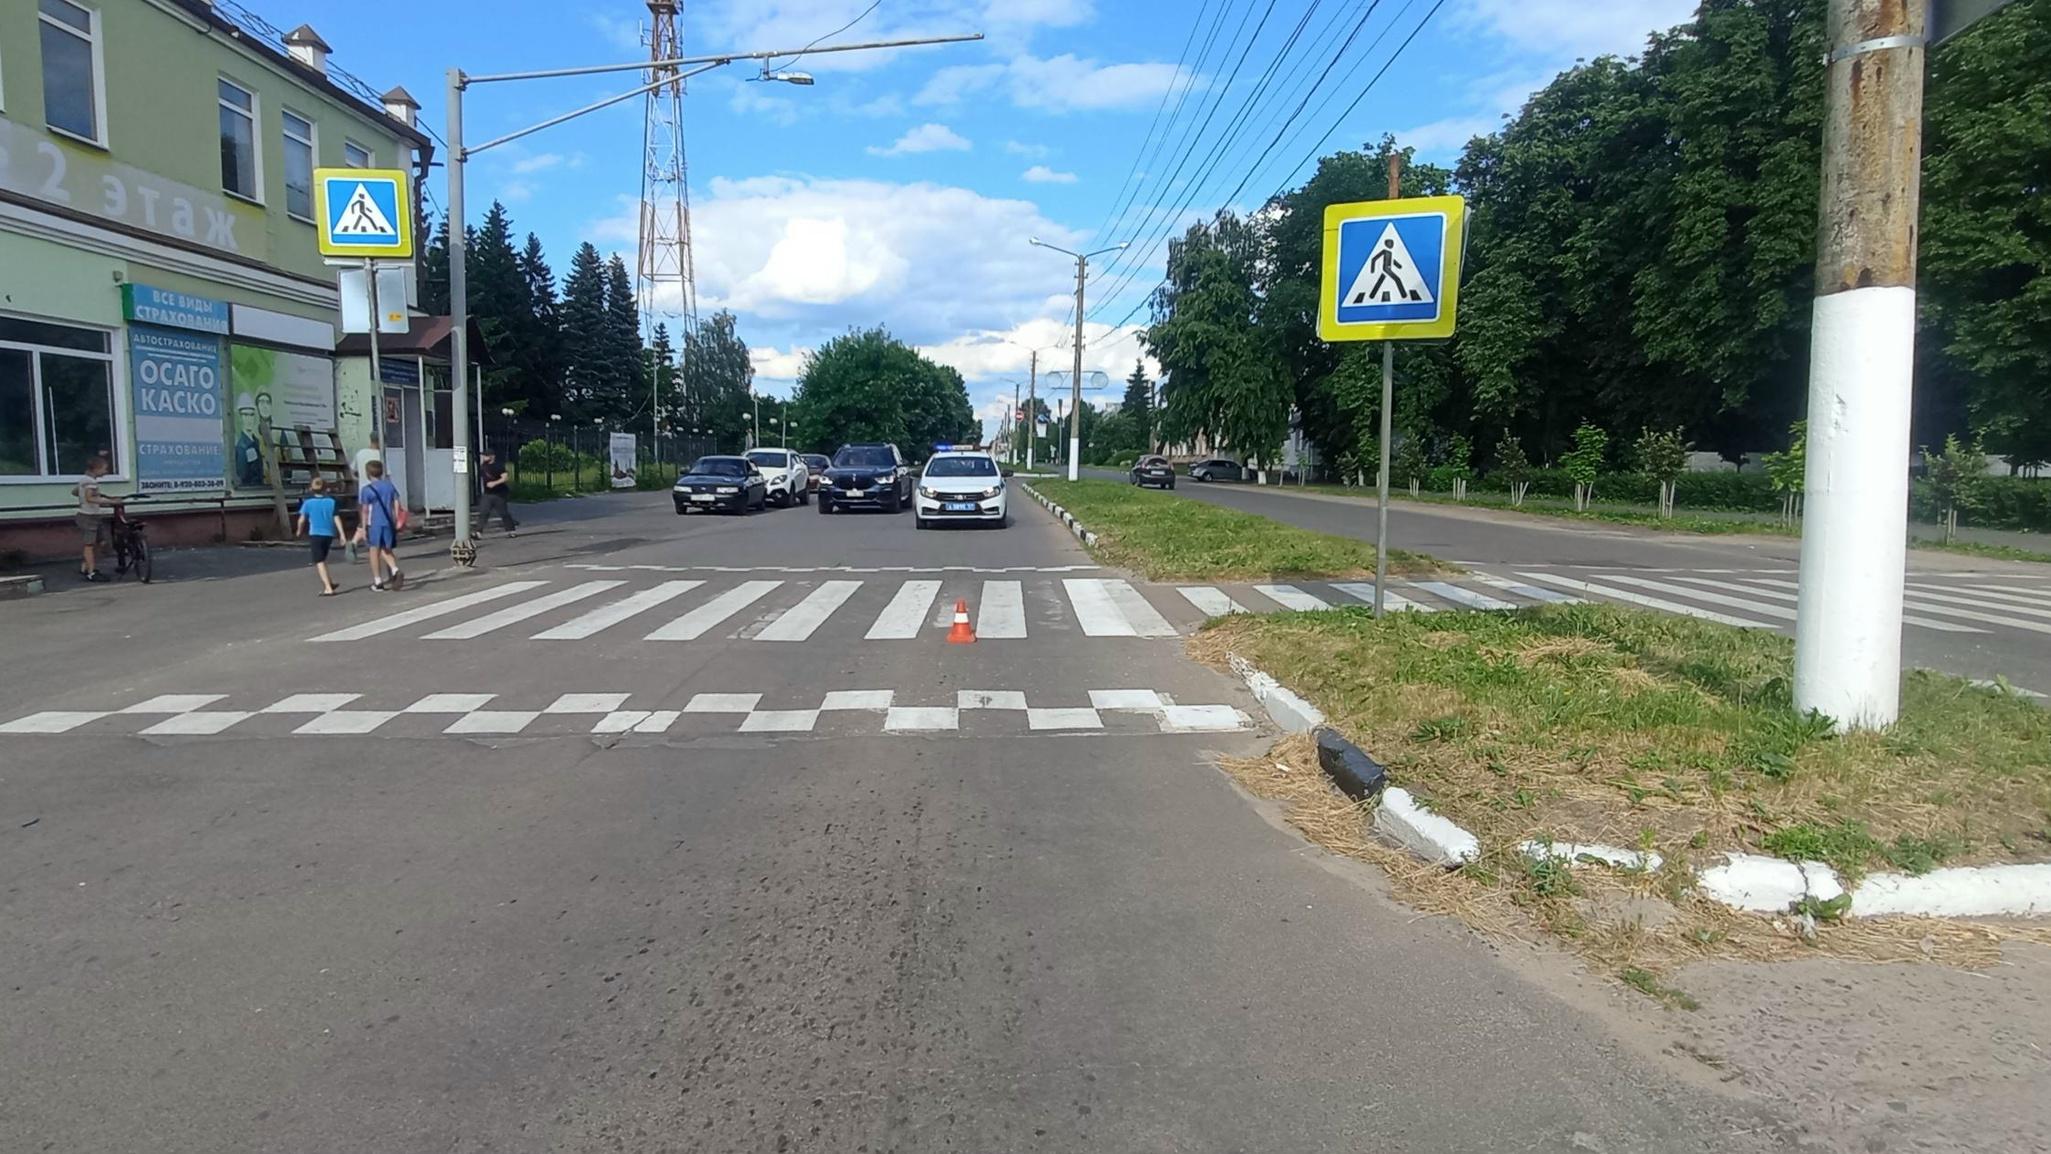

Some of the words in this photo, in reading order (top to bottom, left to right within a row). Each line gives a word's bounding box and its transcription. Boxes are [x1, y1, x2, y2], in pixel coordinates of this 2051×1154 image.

[37, 141, 70, 203] 2
[103, 175, 239, 249] этаж
[152, 289, 175, 306] ВСЕ
[178, 295, 214, 313] ВИДЫ
[136, 304, 229, 331] СТРАХОВАНИЯ
[140, 360, 215, 389] ОСАГО
[141, 388, 216, 415] КАСКО
